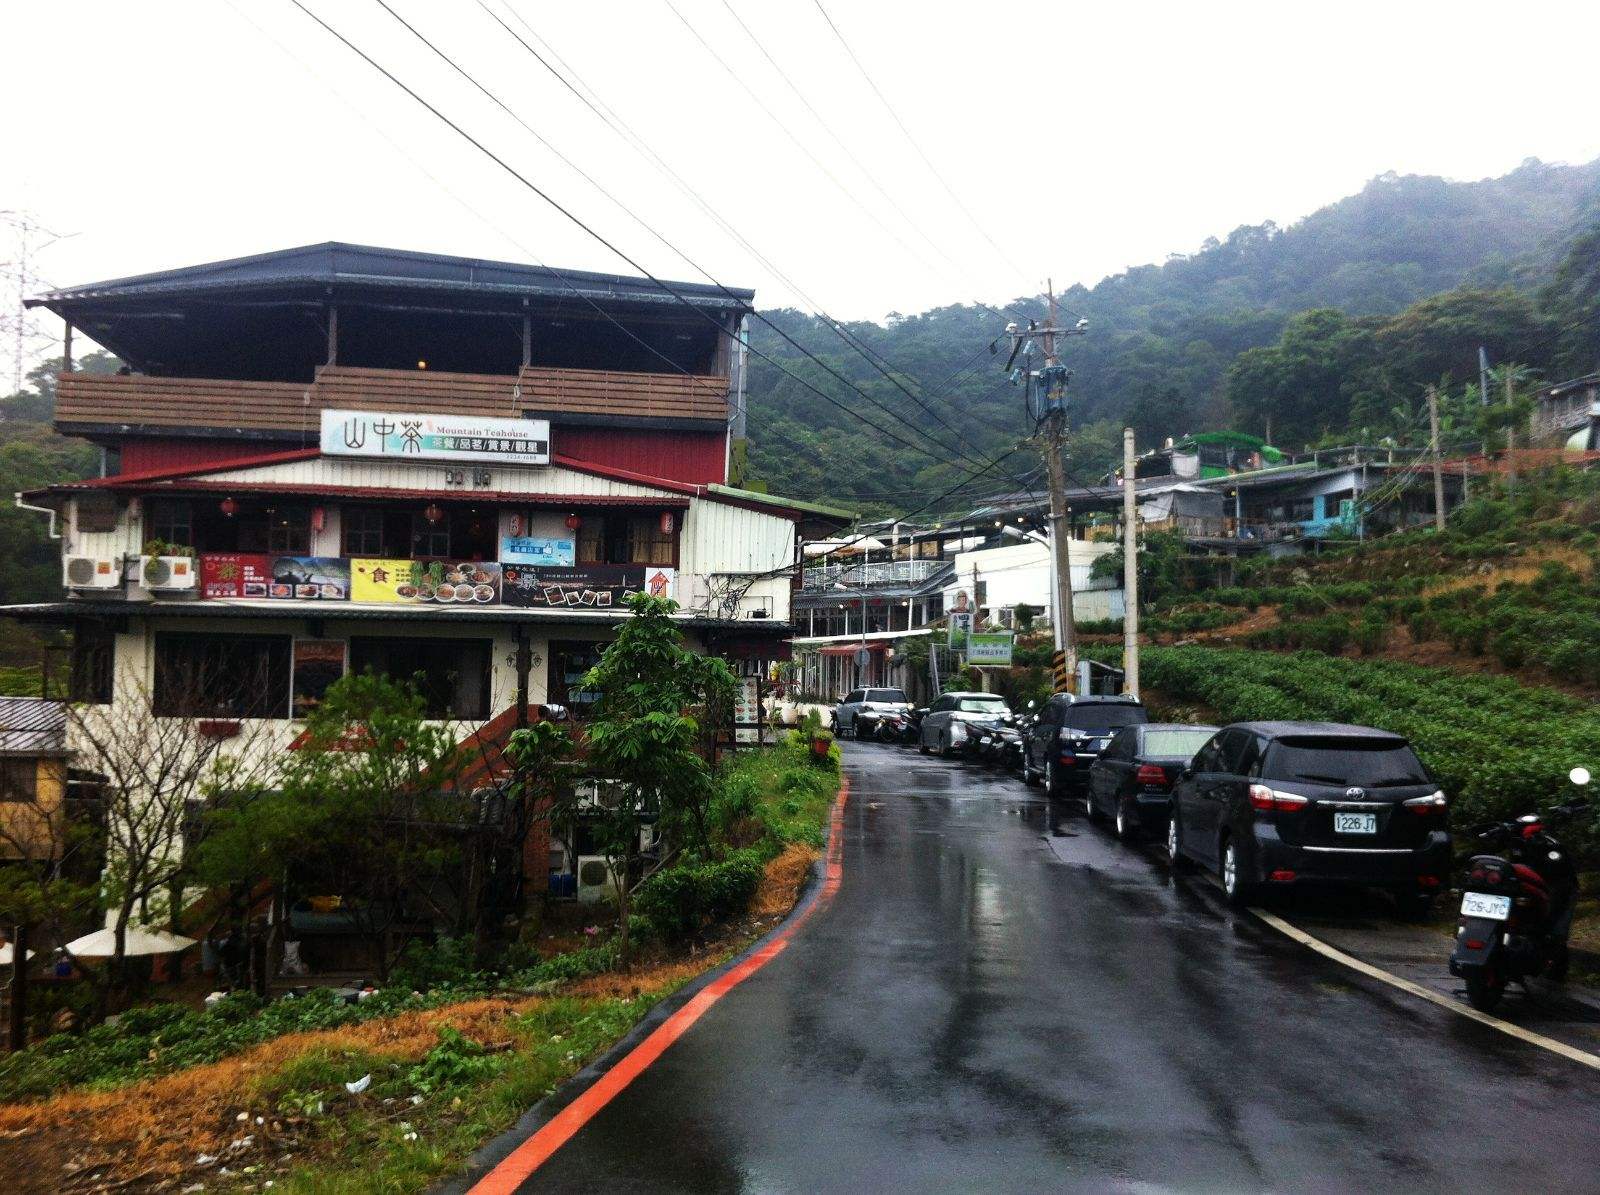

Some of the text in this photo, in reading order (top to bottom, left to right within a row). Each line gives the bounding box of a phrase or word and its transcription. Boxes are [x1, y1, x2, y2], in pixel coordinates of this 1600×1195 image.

[344, 417, 424, 453] 山中茶
[436, 426, 529, 438] Mountain Teahouse
